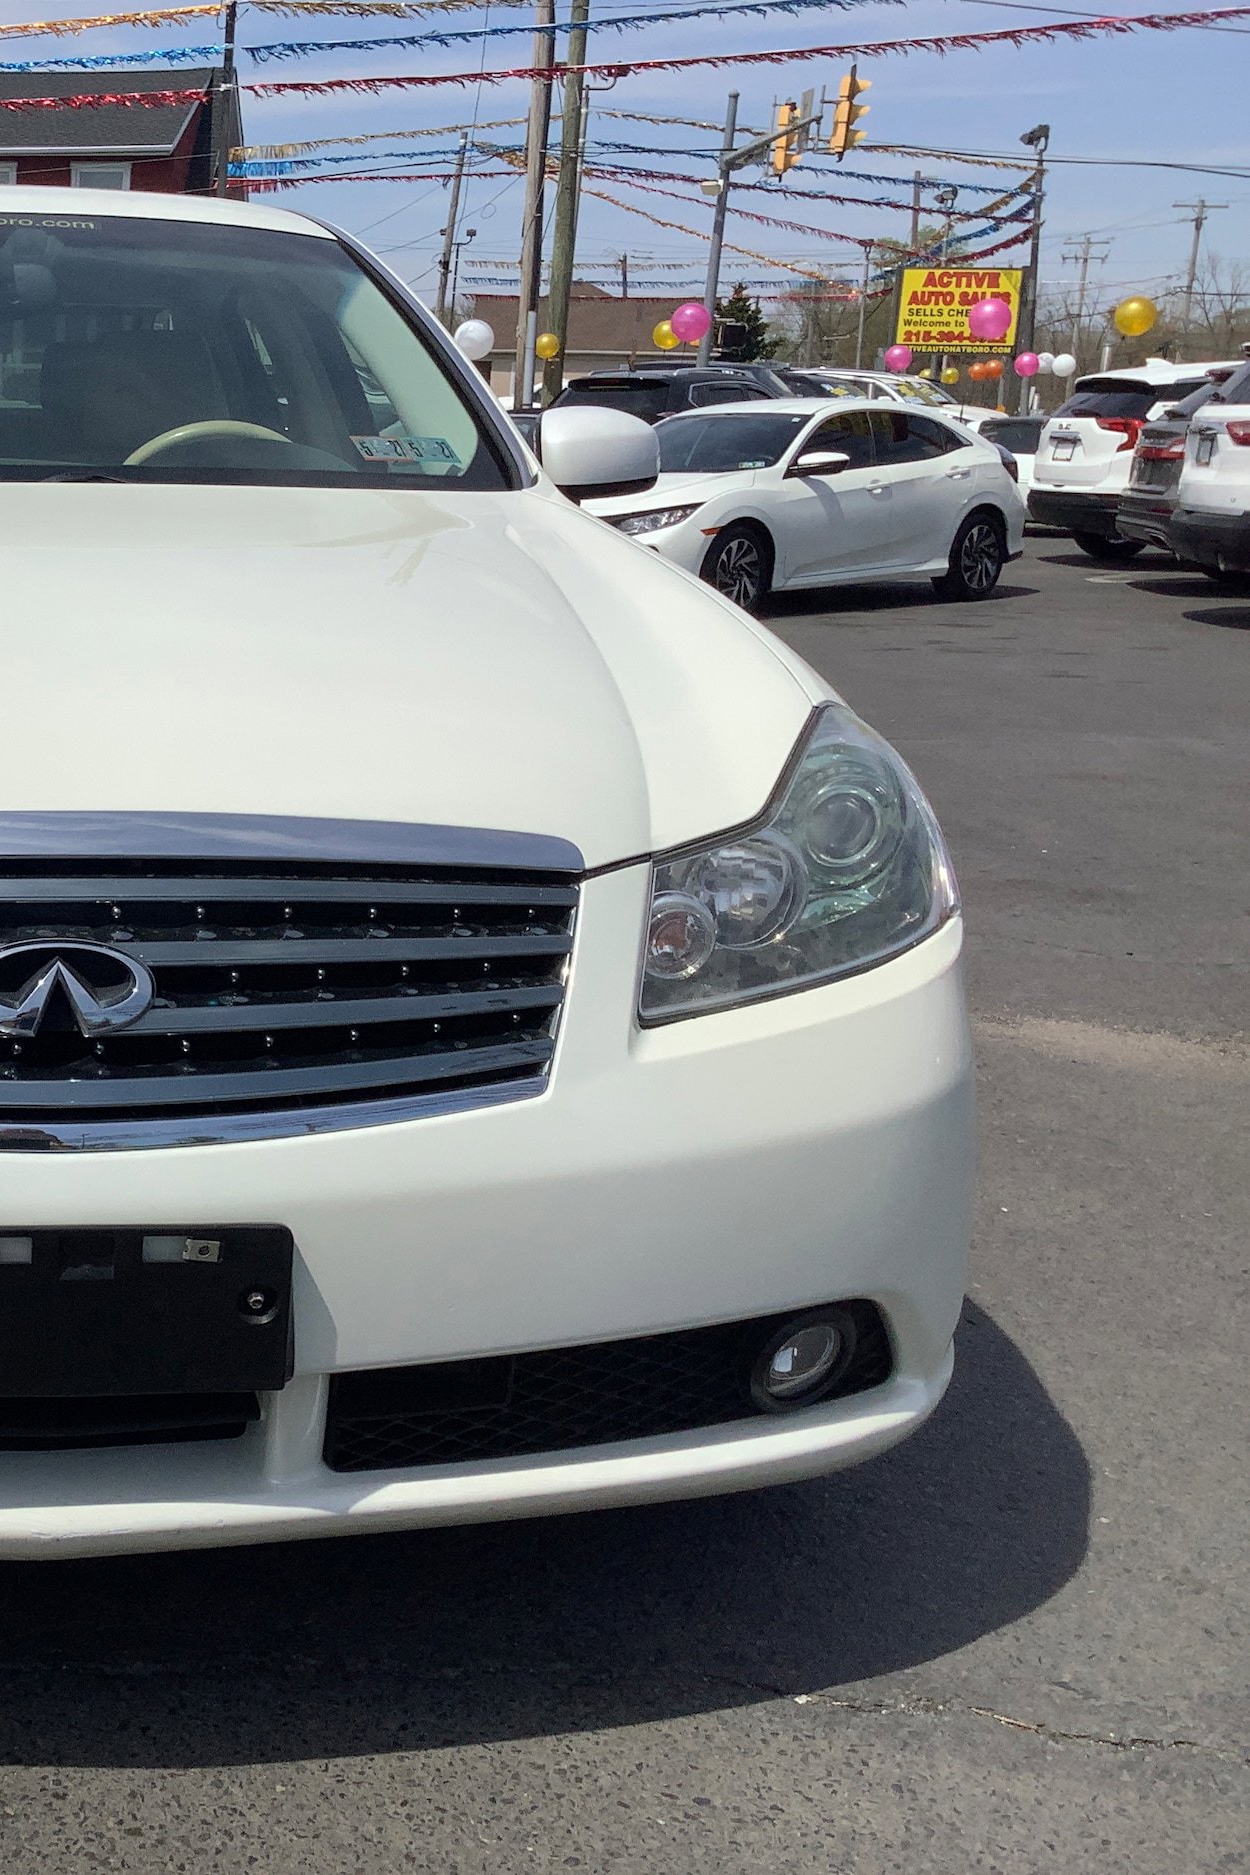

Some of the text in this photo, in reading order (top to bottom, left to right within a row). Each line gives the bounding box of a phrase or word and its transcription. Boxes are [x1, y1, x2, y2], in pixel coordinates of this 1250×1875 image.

[922, 271, 1001, 288] ACTIVE
[907, 290, 955, 306] AUTO
[907, 308, 971, 318] SELLS CHE
[903, 318, 965, 328] Welcome to
[903, 330, 1007, 344] 215-394-
[908, 345, 1012, 354] TIVEAUTOHATBORO.COM
